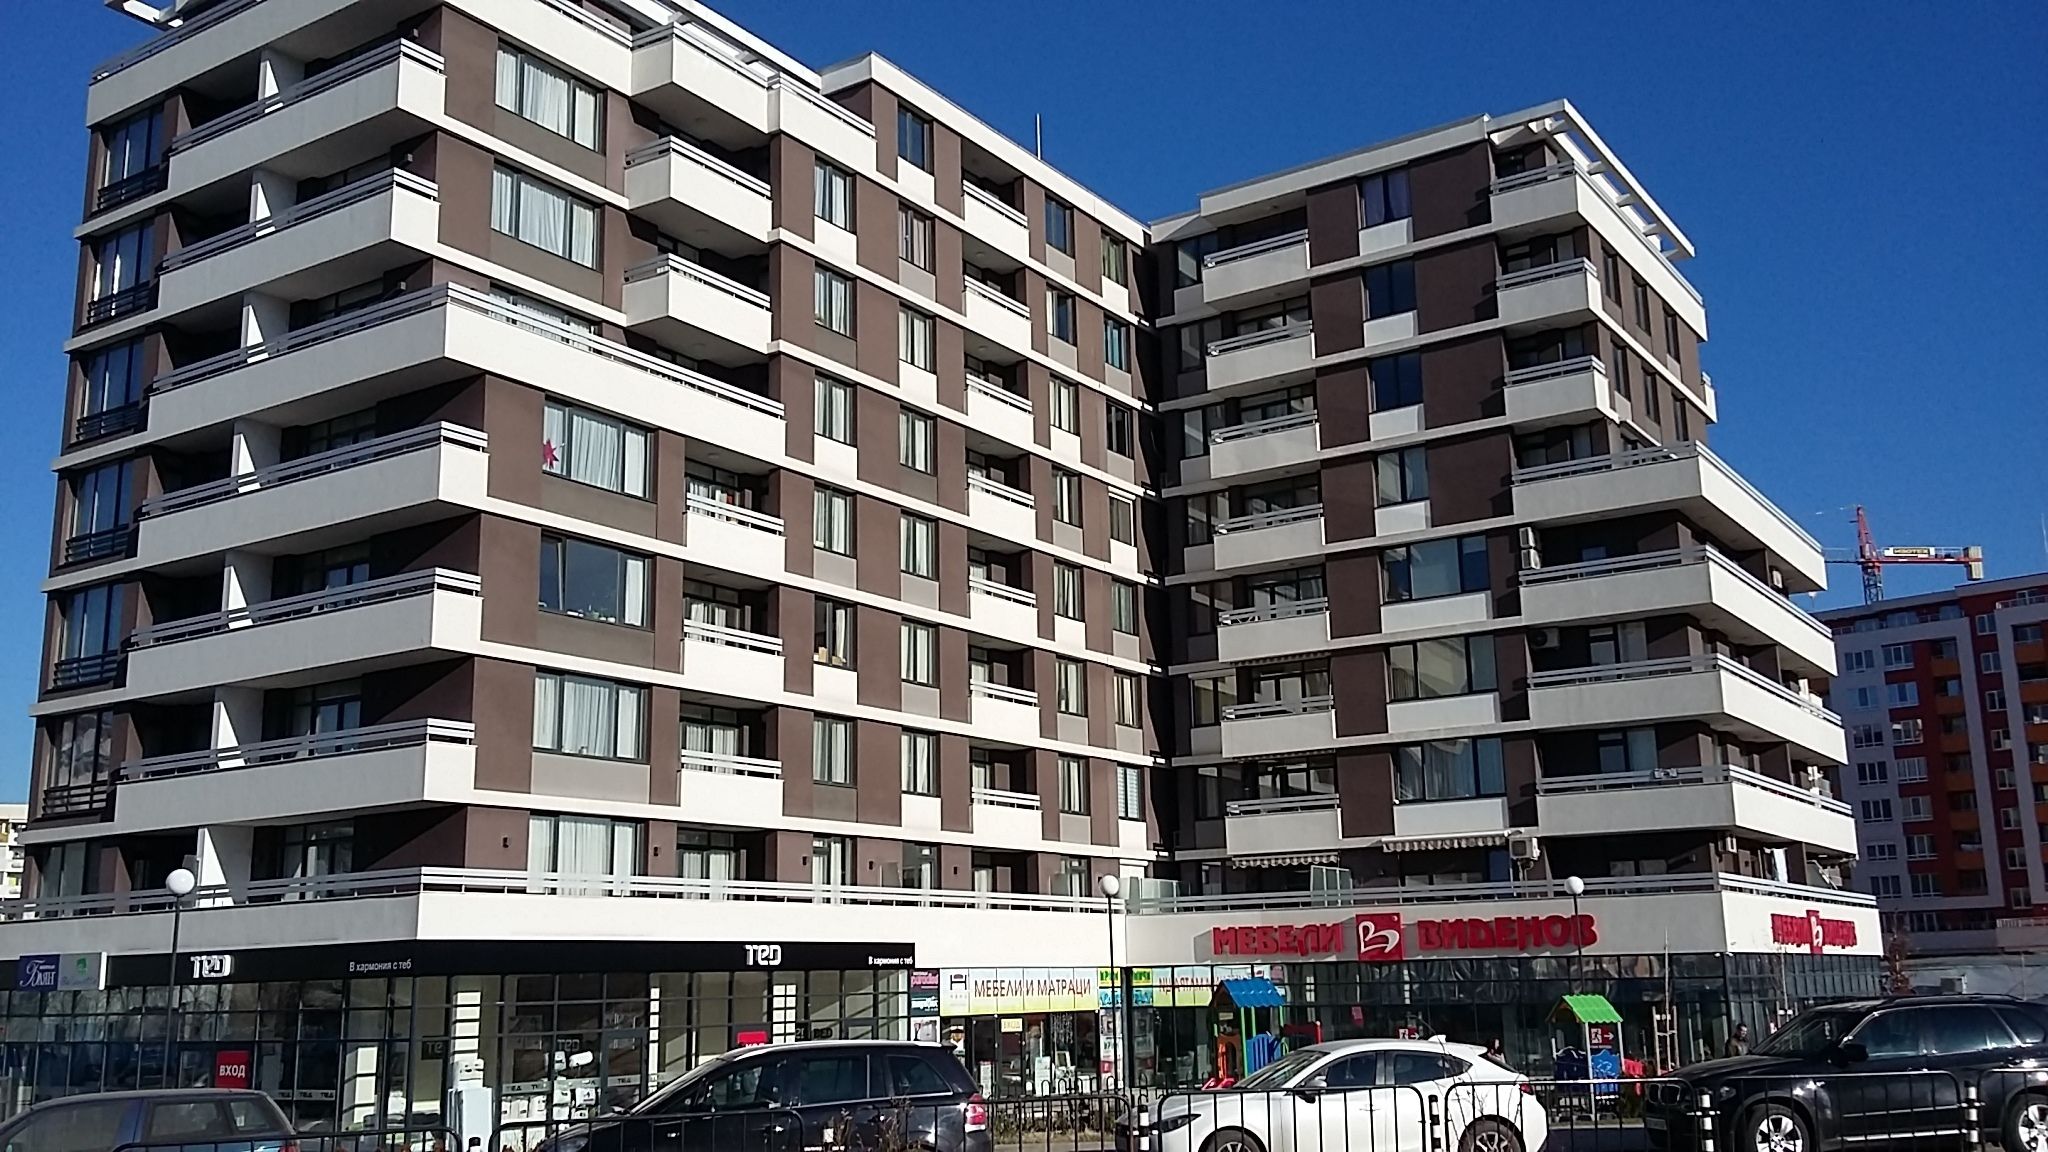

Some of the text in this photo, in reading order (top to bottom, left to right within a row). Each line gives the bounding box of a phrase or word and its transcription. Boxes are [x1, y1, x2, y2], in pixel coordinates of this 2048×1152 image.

[1213, 923, 1343, 956] МЕБЕЛИ
[1417, 914, 1598, 951] ВИДЕНОВ
[349, 961, 355, 972] В
[356, 961, 392, 973] хармония
[398, 958, 412, 970] теб
[868, 955, 874, 965] В
[974, 979, 1024, 998] МЕБЕЛИ
[1026, 979, 1034, 996] И
[1037, 978, 1092, 998] МАТРАЦИ
[219, 1064, 246, 1078] ВХОД
